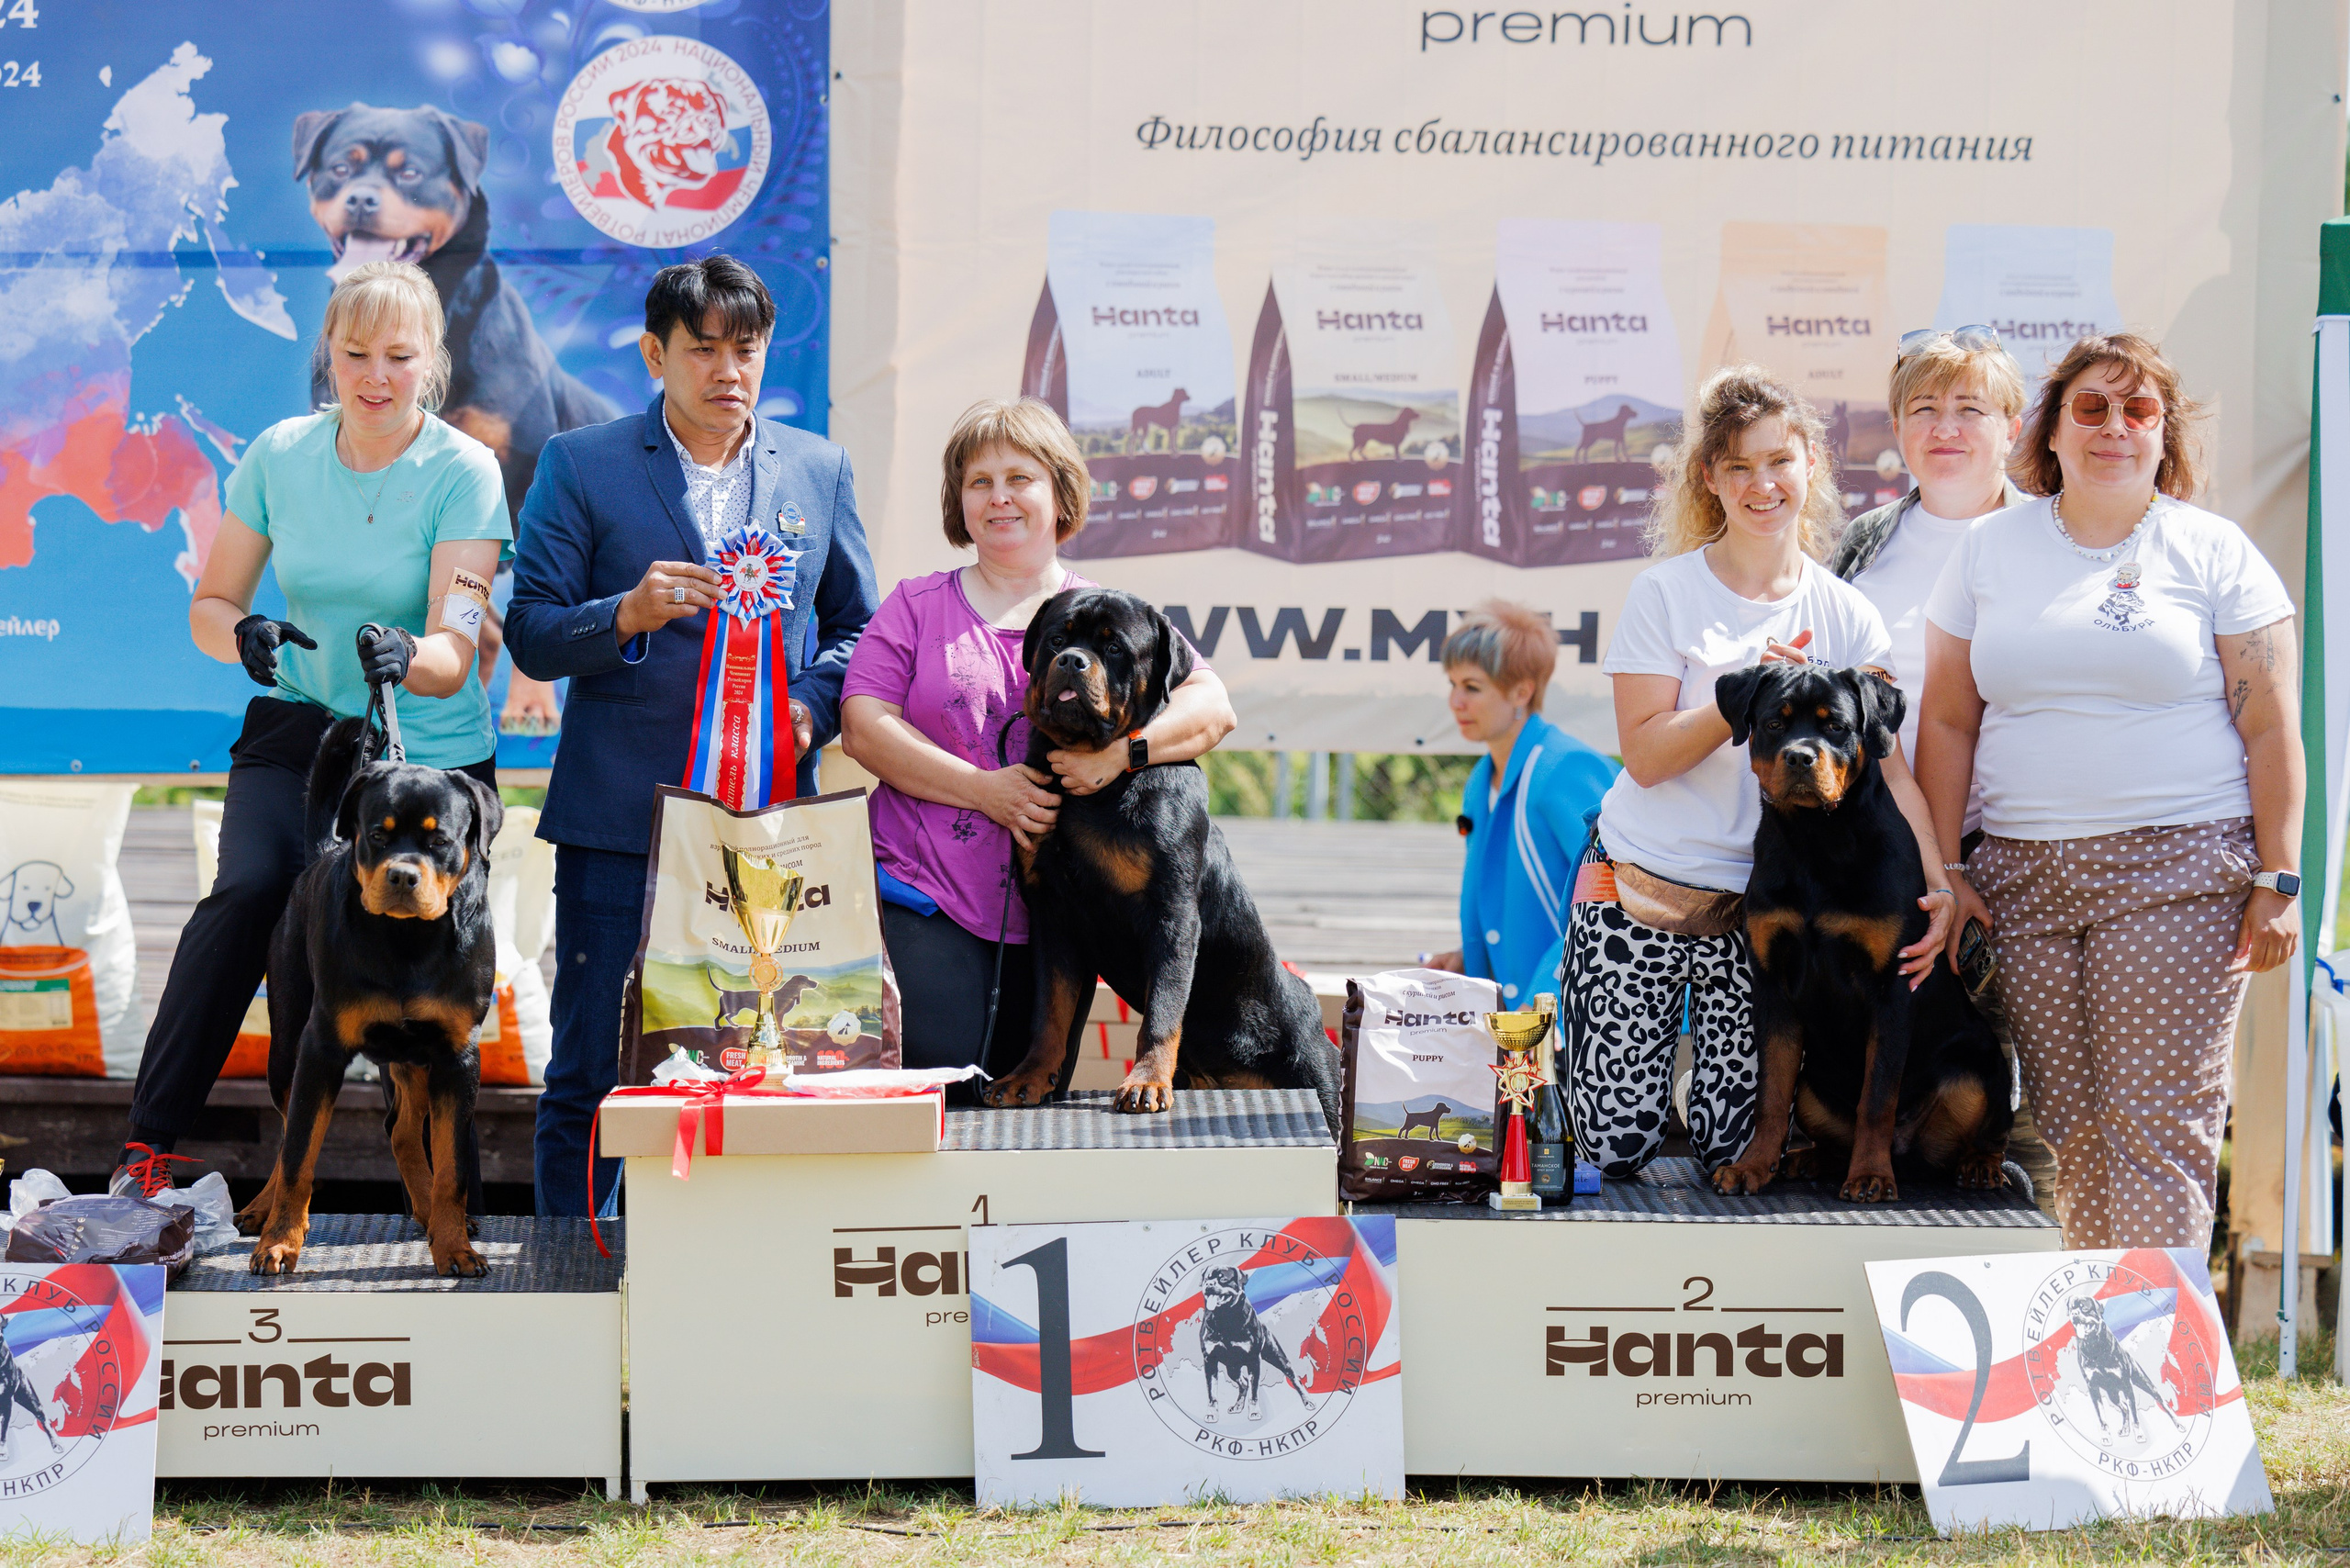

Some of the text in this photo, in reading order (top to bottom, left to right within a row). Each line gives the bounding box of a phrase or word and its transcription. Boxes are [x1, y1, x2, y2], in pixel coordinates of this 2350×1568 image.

[0, 0, 39, 28] 4
[1421, 2, 1751, 53] premium
[616, 39, 664, 63] 2024
[0, 61, 41, 87] 24
[557, 55, 614, 130] РОССИИ
[674, 39, 768, 174] НАЦИОНАЛЬНЫЙ
[1136, 115, 2034, 166] Философия сбалансированного питания
[555, 132, 647, 244] РОТВЕЙЛЕРОВ
[654, 177, 759, 246] ЧЕМПИОНАТ
[1092, 306, 1201, 327] Hanta
[1316, 310, 1424, 330] Hanta
[1540, 313, 1648, 332] Hanta
[1766, 316, 1871, 336] Hanta
[1258, 409, 1279, 544] Hanta
[1481, 408, 1504, 548] Hanta
[2094, 618, 2155, 633] ОЛЬБУРД
[731, 714, 742, 759] класса
[797, 834, 810, 844] для
[800, 842, 822, 852] пород
[1438, 991, 1456, 1001] рисом
[1384, 1009, 1476, 1027] Hanta
[1409, 1027, 1448, 1036] premium
[725, 1051, 746, 1059] FRESH
[1412, 1054, 1444, 1063] PUPPY
[1373, 1156, 1389, 1167] NWC
[971, 1194, 997, 1226] 1
[1682, 1276, 1715, 1311] 2
[248, 1308, 283, 1343] 3
[1137, 1232, 1363, 1401] РОТВЕЙЛЕР КЛУБ РОССИИ
[4, 1277, 118, 1441] КЛУБ РОССИИ
[1001, 1237, 1106, 1461] 1
[1546, 1323, 1844, 1378] Hanta
[2027, 1264, 2211, 1426] РОТВЕЙЛЕР КЛУБ РОССИИ
[1900, 1271, 2030, 1487] 2
[1636, 1388, 1752, 1408] premium
[204, 1420, 319, 1441] premium
[1194, 1420, 1317, 1456] РКФ-НКПР
[2098, 1442, 2192, 1476] РКФ-НКПР
[4, 1463, 64, 1496] НКПР
